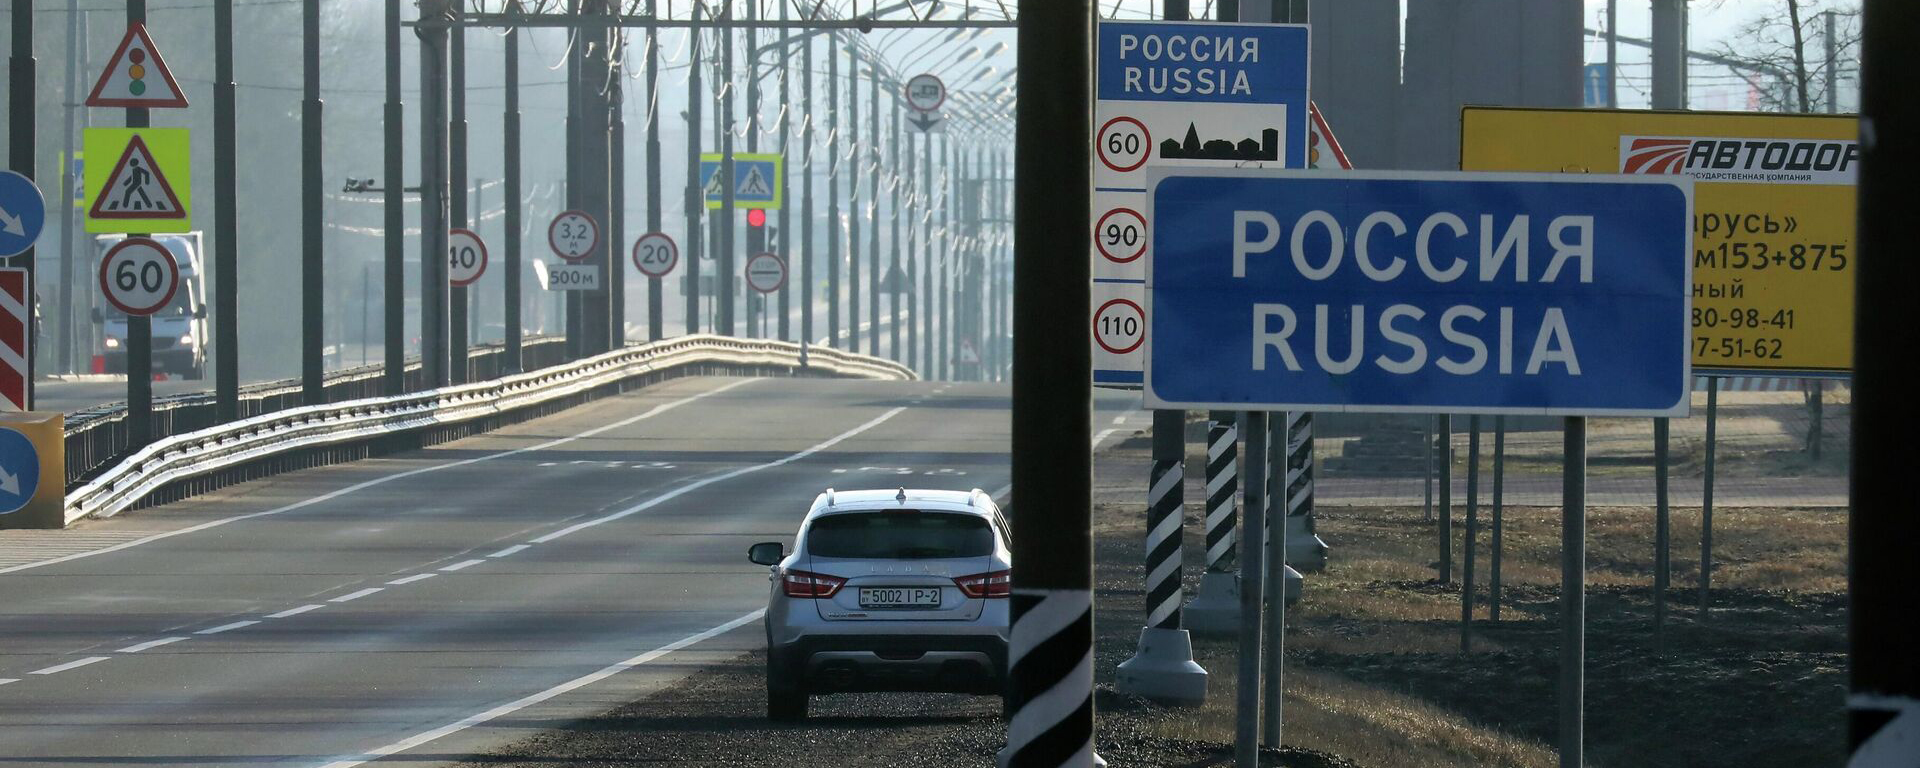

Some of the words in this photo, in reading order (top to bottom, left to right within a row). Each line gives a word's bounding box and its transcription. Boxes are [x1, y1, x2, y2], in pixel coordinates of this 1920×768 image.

[1120, 34, 1259, 63] РОССИЯ
[1125, 66, 1252, 95] RUSSIA
[1108, 132, 1140, 155] 60
[1766, 173, 1812, 182] КОМПАНИЯ
[561, 223, 588, 240] 3,2
[1107, 224, 1138, 246] 90
[1693, 213, 1797, 239] русь»
[642, 244, 670, 264] 20
[1232, 209, 1594, 283] РОССИЯ
[116, 260, 163, 293] 60
[1102, 316, 1137, 337] 110
[1252, 303, 1582, 375] RUSSIA
[1692, 337, 1783, 359] 7-51-62
[872, 590, 902, 603] 5002
